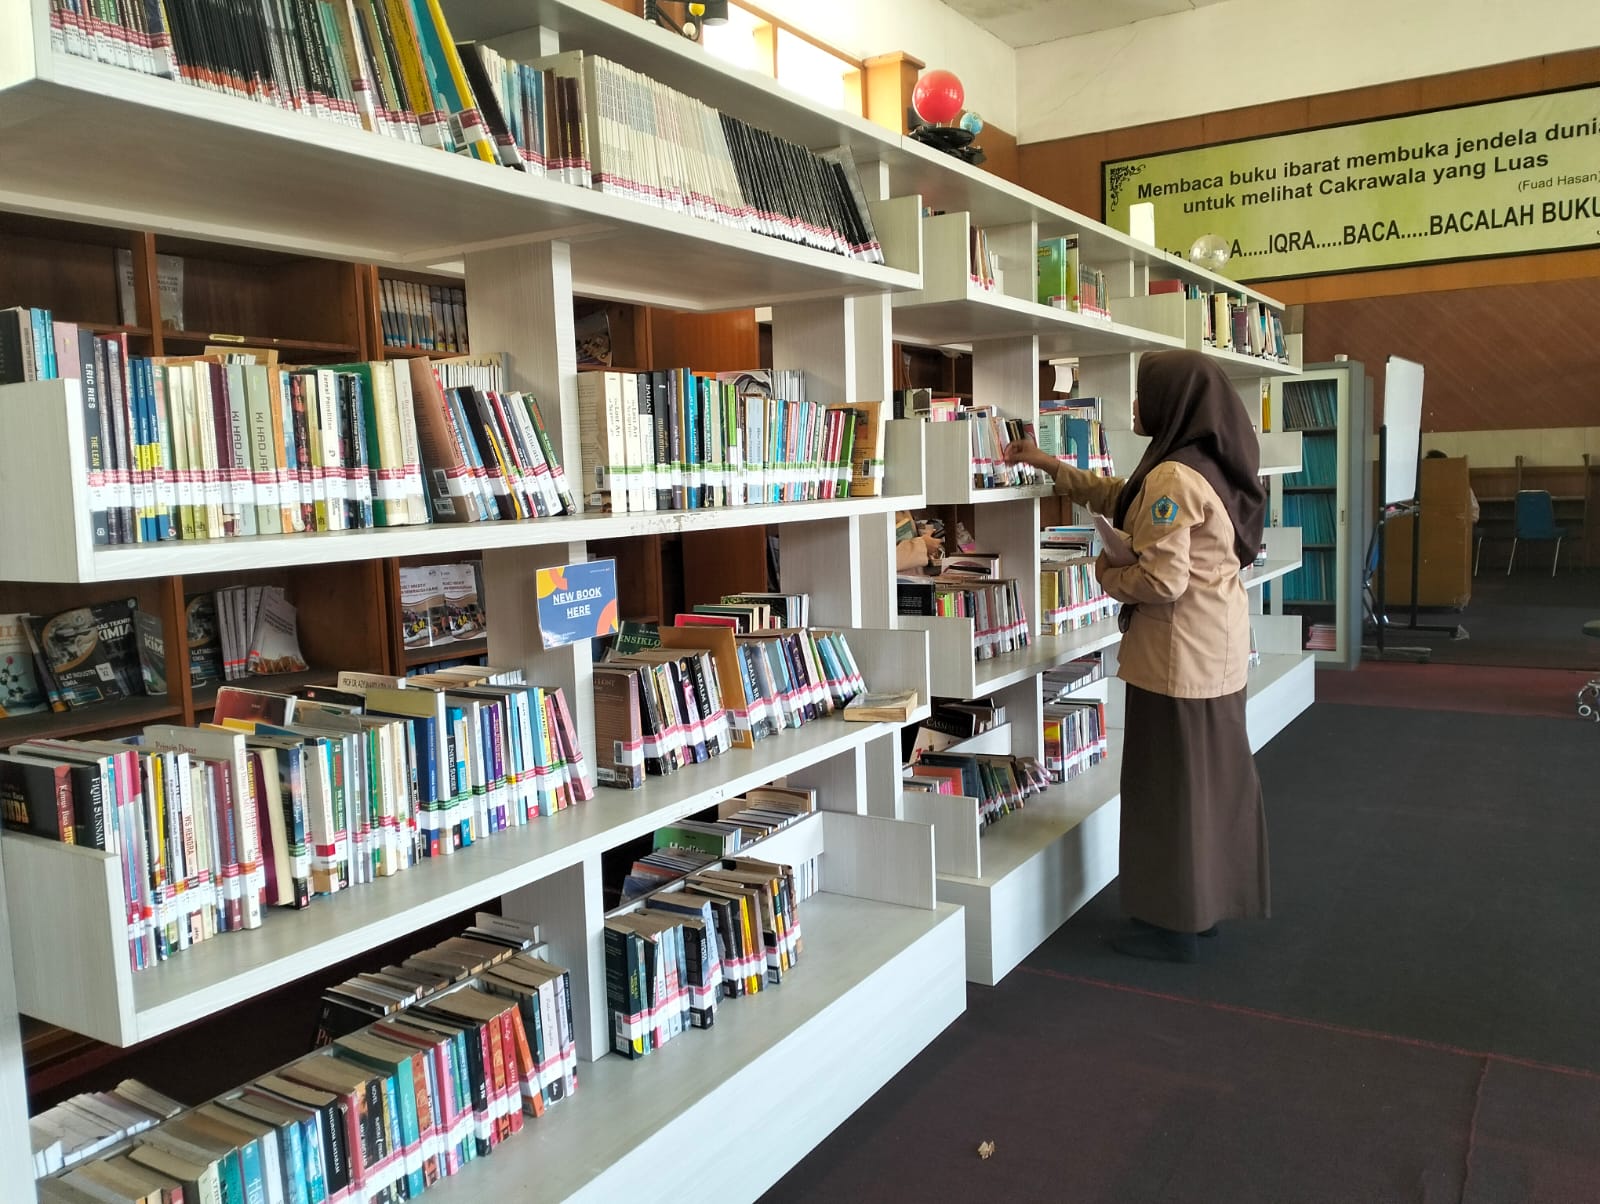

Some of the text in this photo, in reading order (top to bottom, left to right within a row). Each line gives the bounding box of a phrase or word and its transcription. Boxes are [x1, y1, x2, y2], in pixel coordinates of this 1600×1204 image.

[1138, 175, 1223, 199] Membaca
[1230, 166, 1277, 186] buku
[1284, 155, 1340, 178] ibarat
[1346, 141, 1449, 169] membuka
[1455, 128, 1537, 158] jendela
[1183, 153, 1549, 214] untuk melihat Cakrawala yang Luas
[1518, 177, 1553, 193] (Fuad
[86, 363, 96, 409] ERIC RIES
[231, 411, 240, 422] KI
[255, 412, 264, 423] KI
[553, 587, 602, 604] NEW BOOK
[566, 604, 591, 617] HERE
[619, 633, 661, 648] ENSIKLO
[746, 658, 756, 687] REALM
[696, 672, 707, 702] REALM
[59, 784, 70, 809] Kamus
[63, 825, 74, 845] SUN
[93, 807, 105, 846] SUNNAH
[184, 815, 195, 856] WS RENDRA
[331, 1141, 341, 1174] MATARAM
